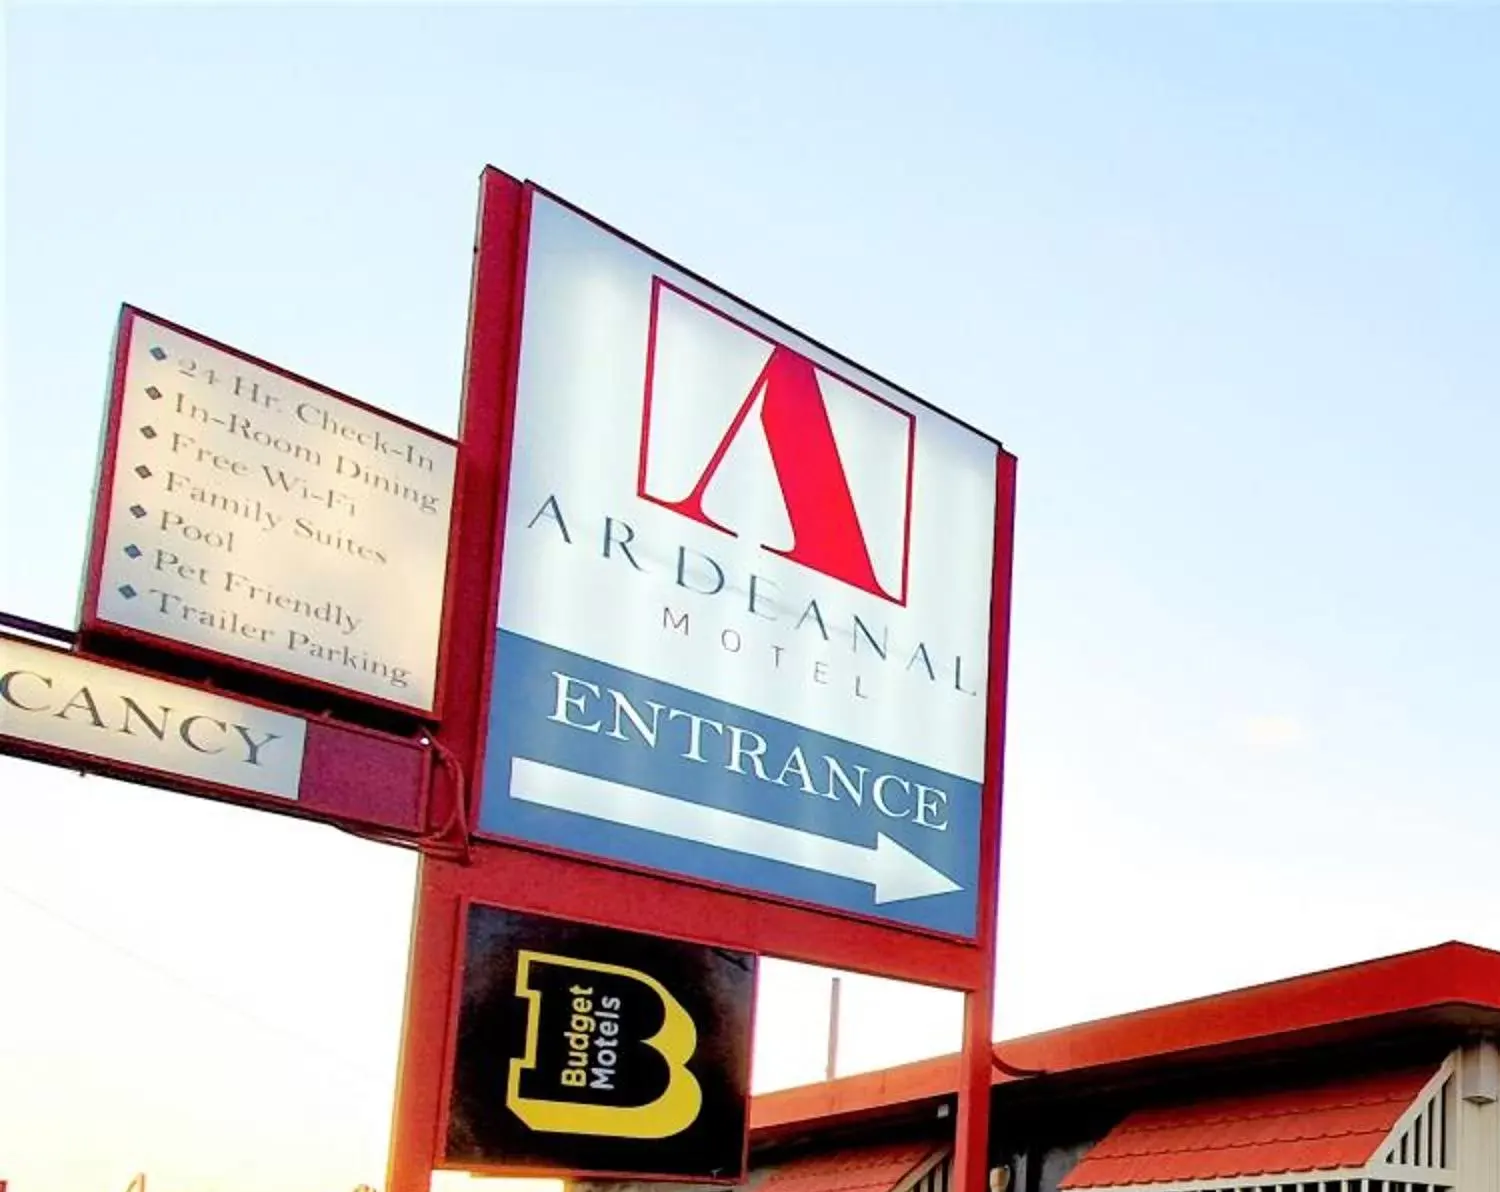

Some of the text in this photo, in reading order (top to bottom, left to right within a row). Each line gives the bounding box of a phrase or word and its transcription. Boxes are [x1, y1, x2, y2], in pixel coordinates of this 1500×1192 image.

[174, 392, 439, 514] In-Room Dining
[177, 356, 434, 473] 24 Hr. Check-In
[165, 470, 388, 564] Family Suites
[171, 432, 356, 518] Free Wi-Fi
[160, 510, 235, 552] Pool
[149, 588, 413, 688] Trailer Parking
[154, 549, 363, 635] Pet Friendly
[527, 493, 978, 698] ARDEANAL
[661, 605, 869, 701] MOTEL
[546, 670, 950, 832] ENTRANCE
[561, 984, 597, 1087] Budget
[590, 996, 621, 1090] Motels
